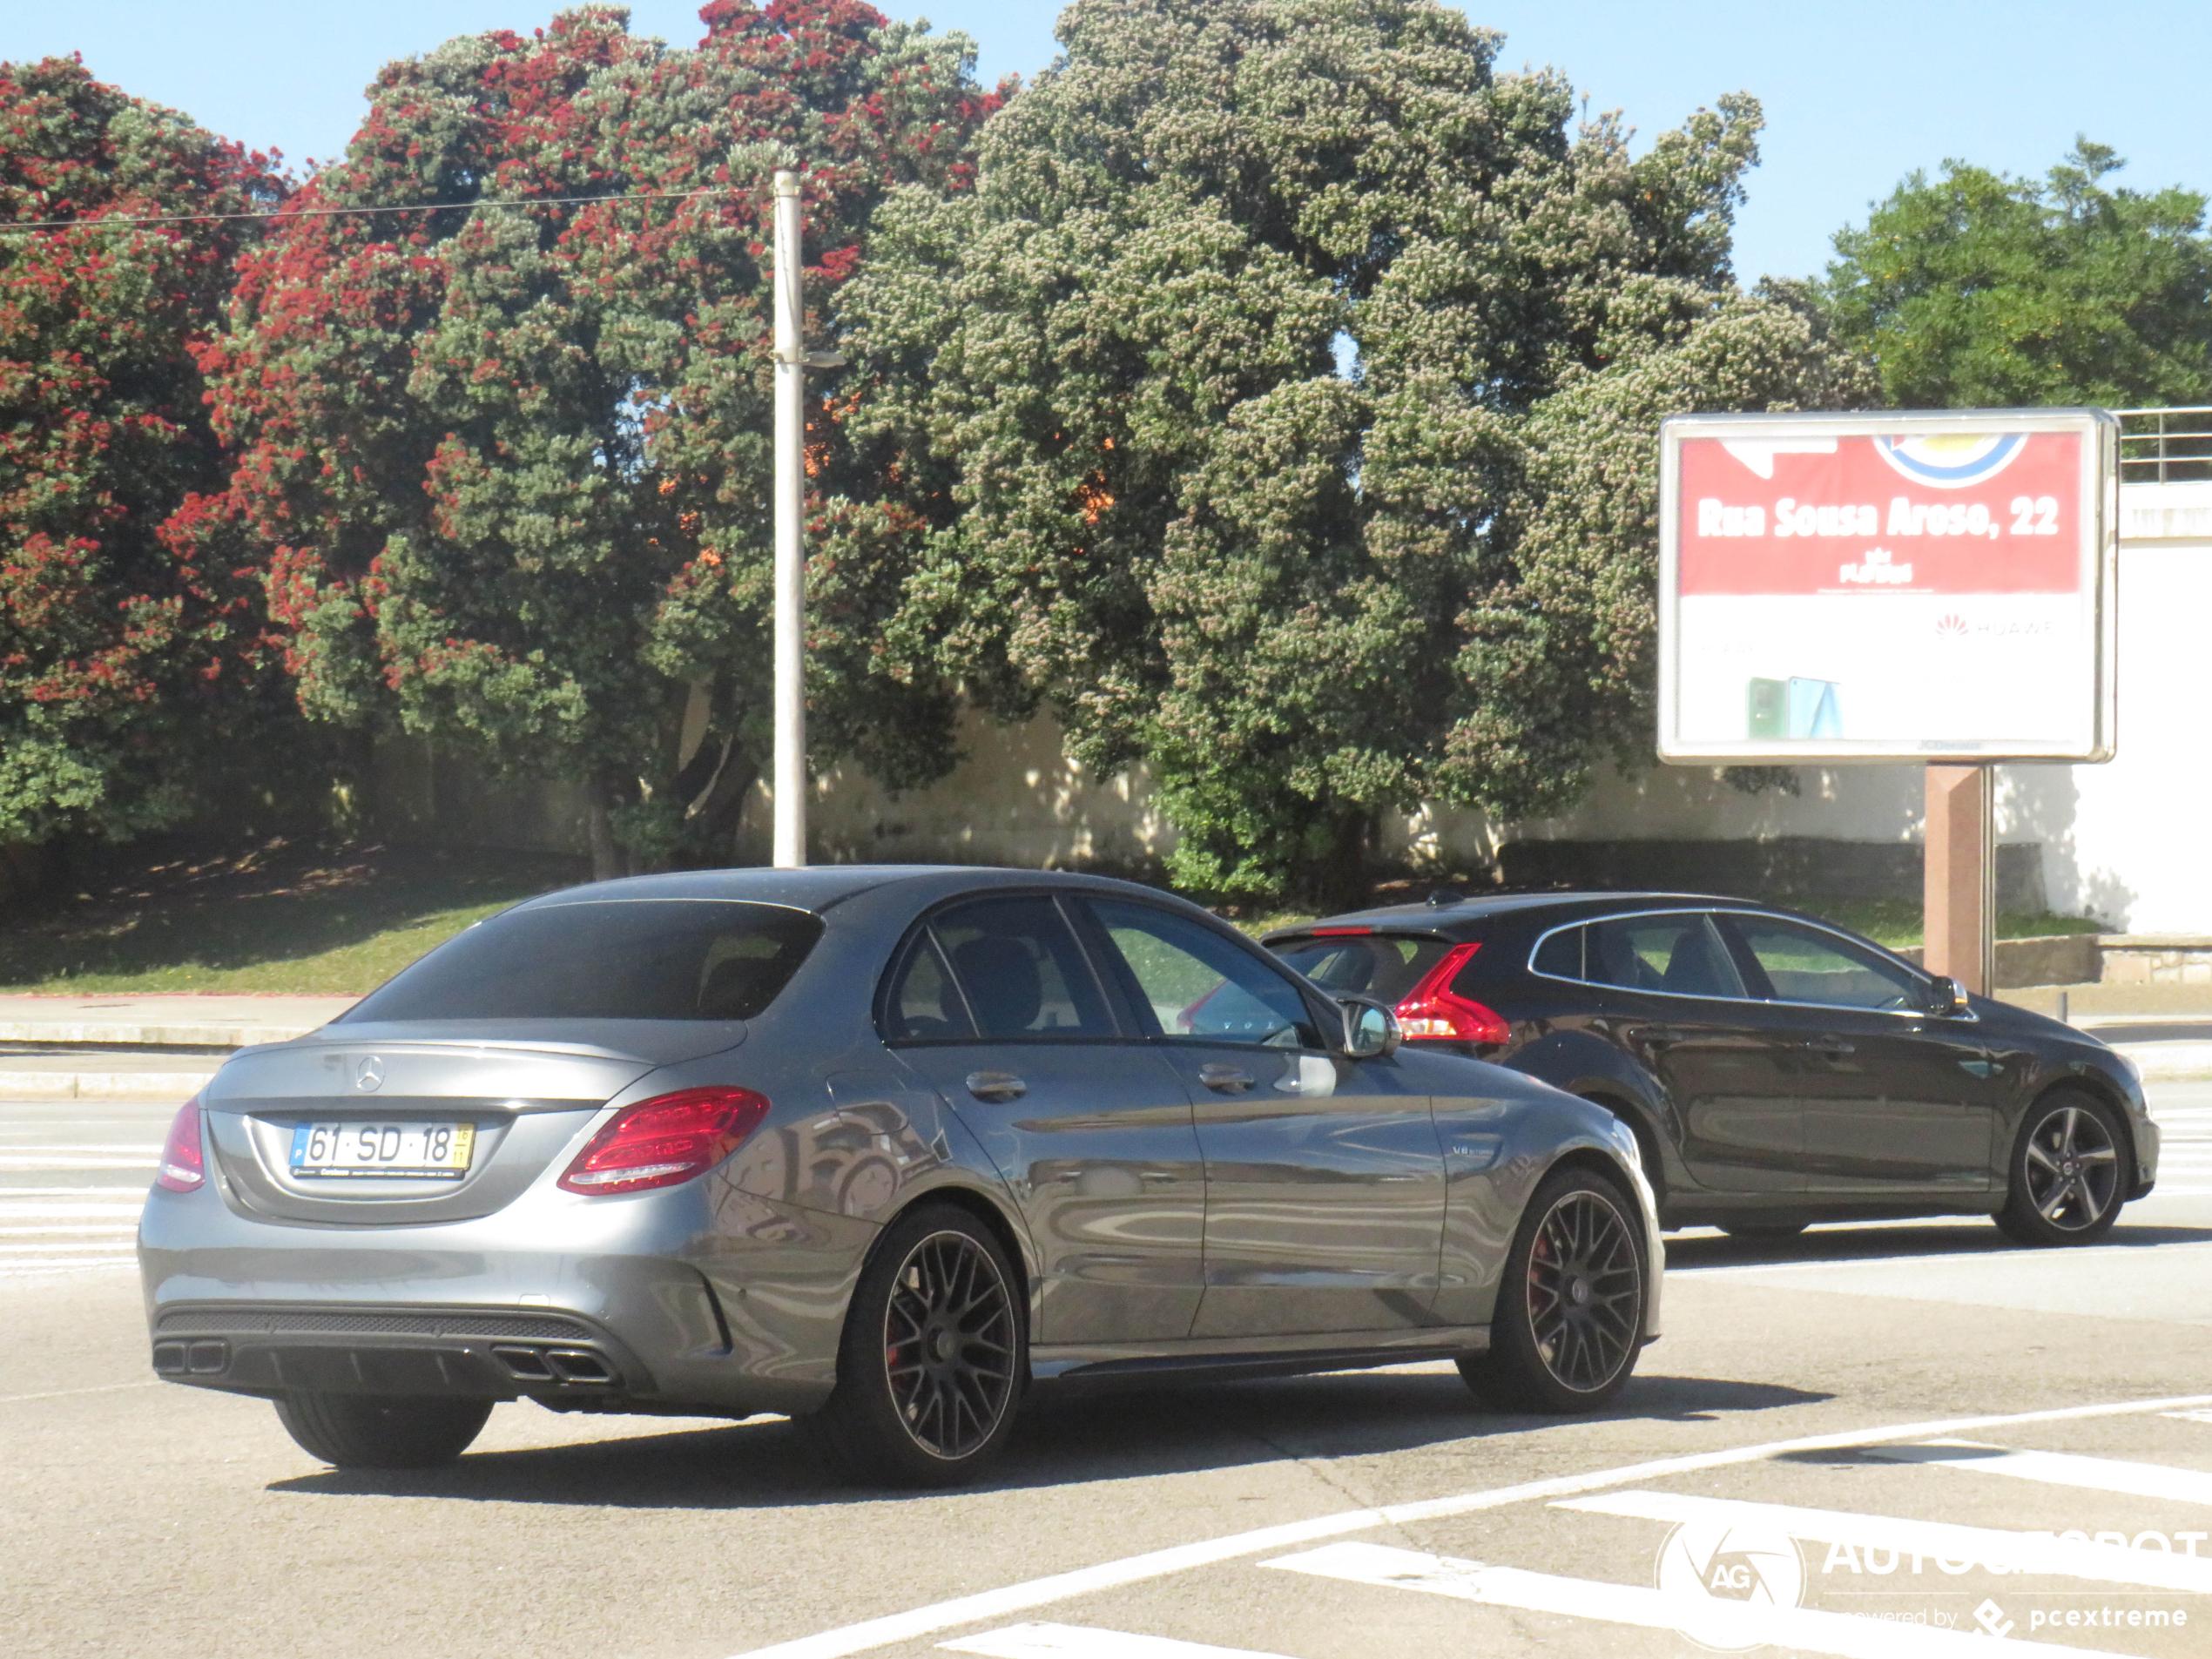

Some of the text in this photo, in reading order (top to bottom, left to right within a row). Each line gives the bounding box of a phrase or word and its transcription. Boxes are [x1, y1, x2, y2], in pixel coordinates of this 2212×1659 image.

[1698, 496, 2058, 540] Rua Sousa Aroso, 22
[1977, 620, 2060, 637] HUAWE
[1224, 1021, 1275, 1030] VOL
[294, 1149, 303, 1159] P
[357, 1126, 401, 1162] SD
